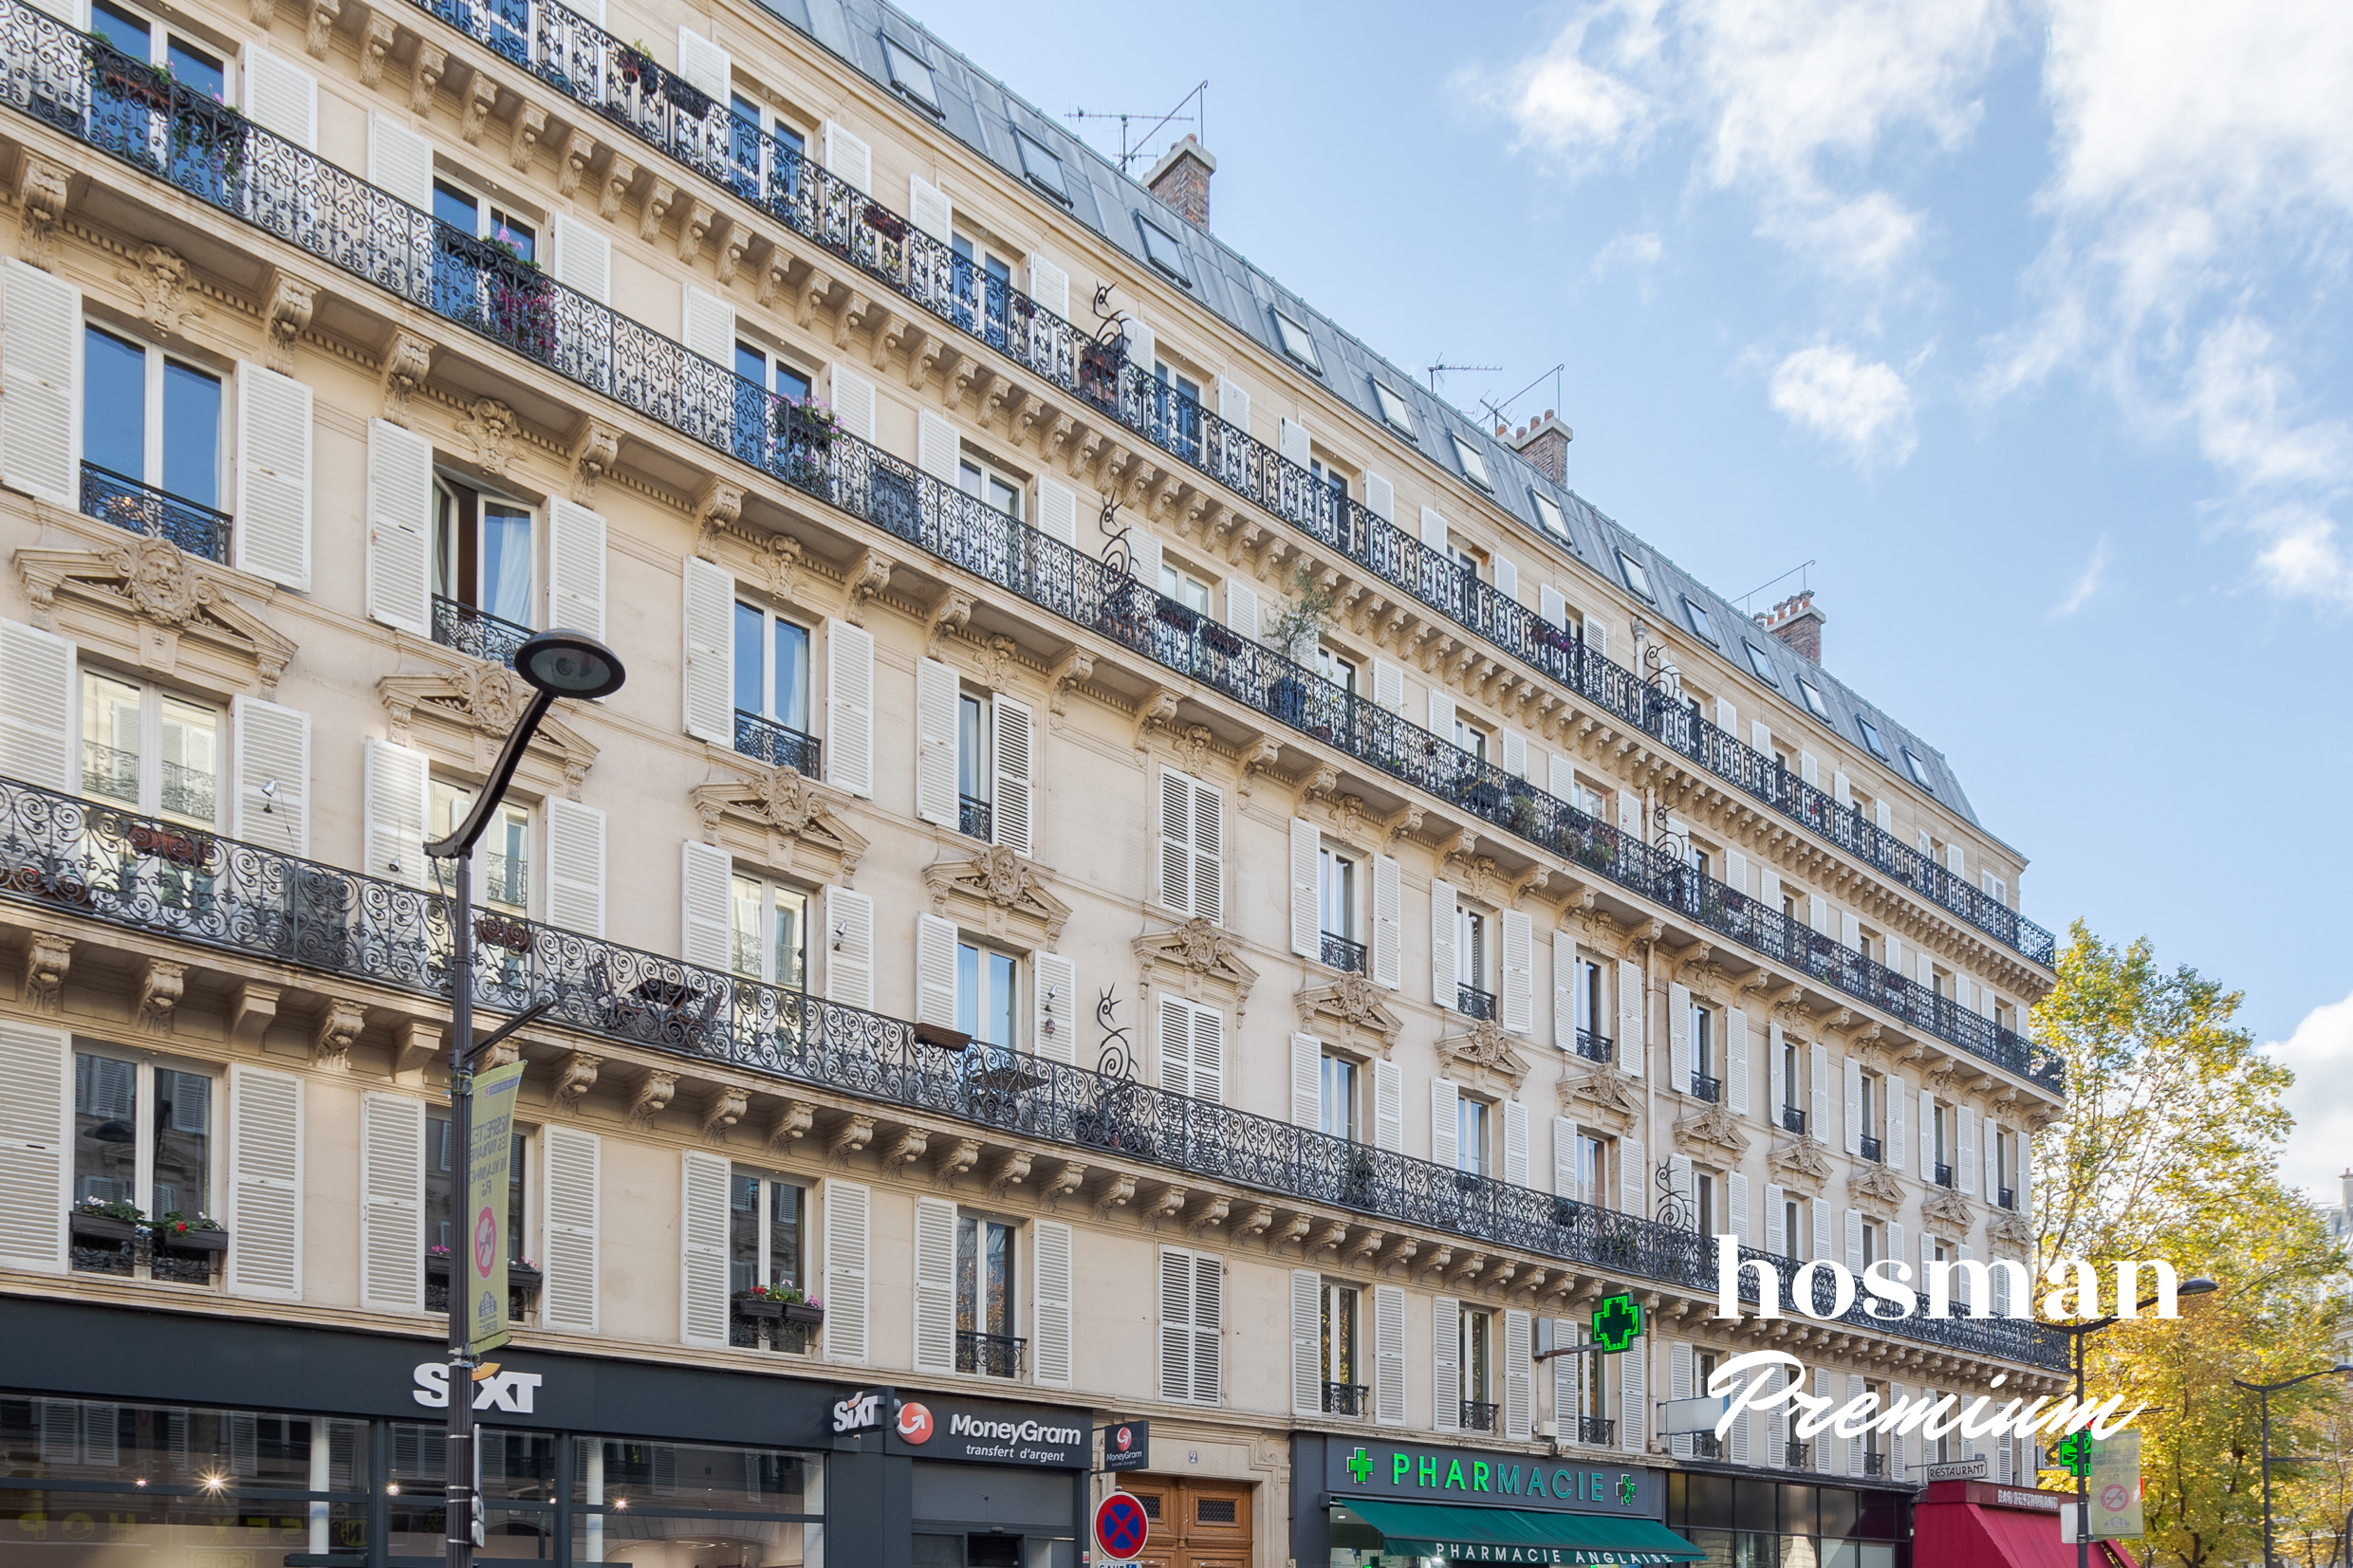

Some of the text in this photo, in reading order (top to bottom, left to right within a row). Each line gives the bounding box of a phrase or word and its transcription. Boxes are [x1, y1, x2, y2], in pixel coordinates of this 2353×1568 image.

[949, 1413, 1082, 1445] MoneyGram
[966, 1445, 1065, 1463] transfert d'argent
[1105, 1450, 1142, 1462] MoneyGram
[1190, 1451, 1196, 1463] 2
[1393, 1452, 1604, 1503] PHARMACIE
[1930, 1464, 1985, 1478] RESTAURANT
[1436, 1542, 1674, 1564] PHARMACIE ANGLAISE
